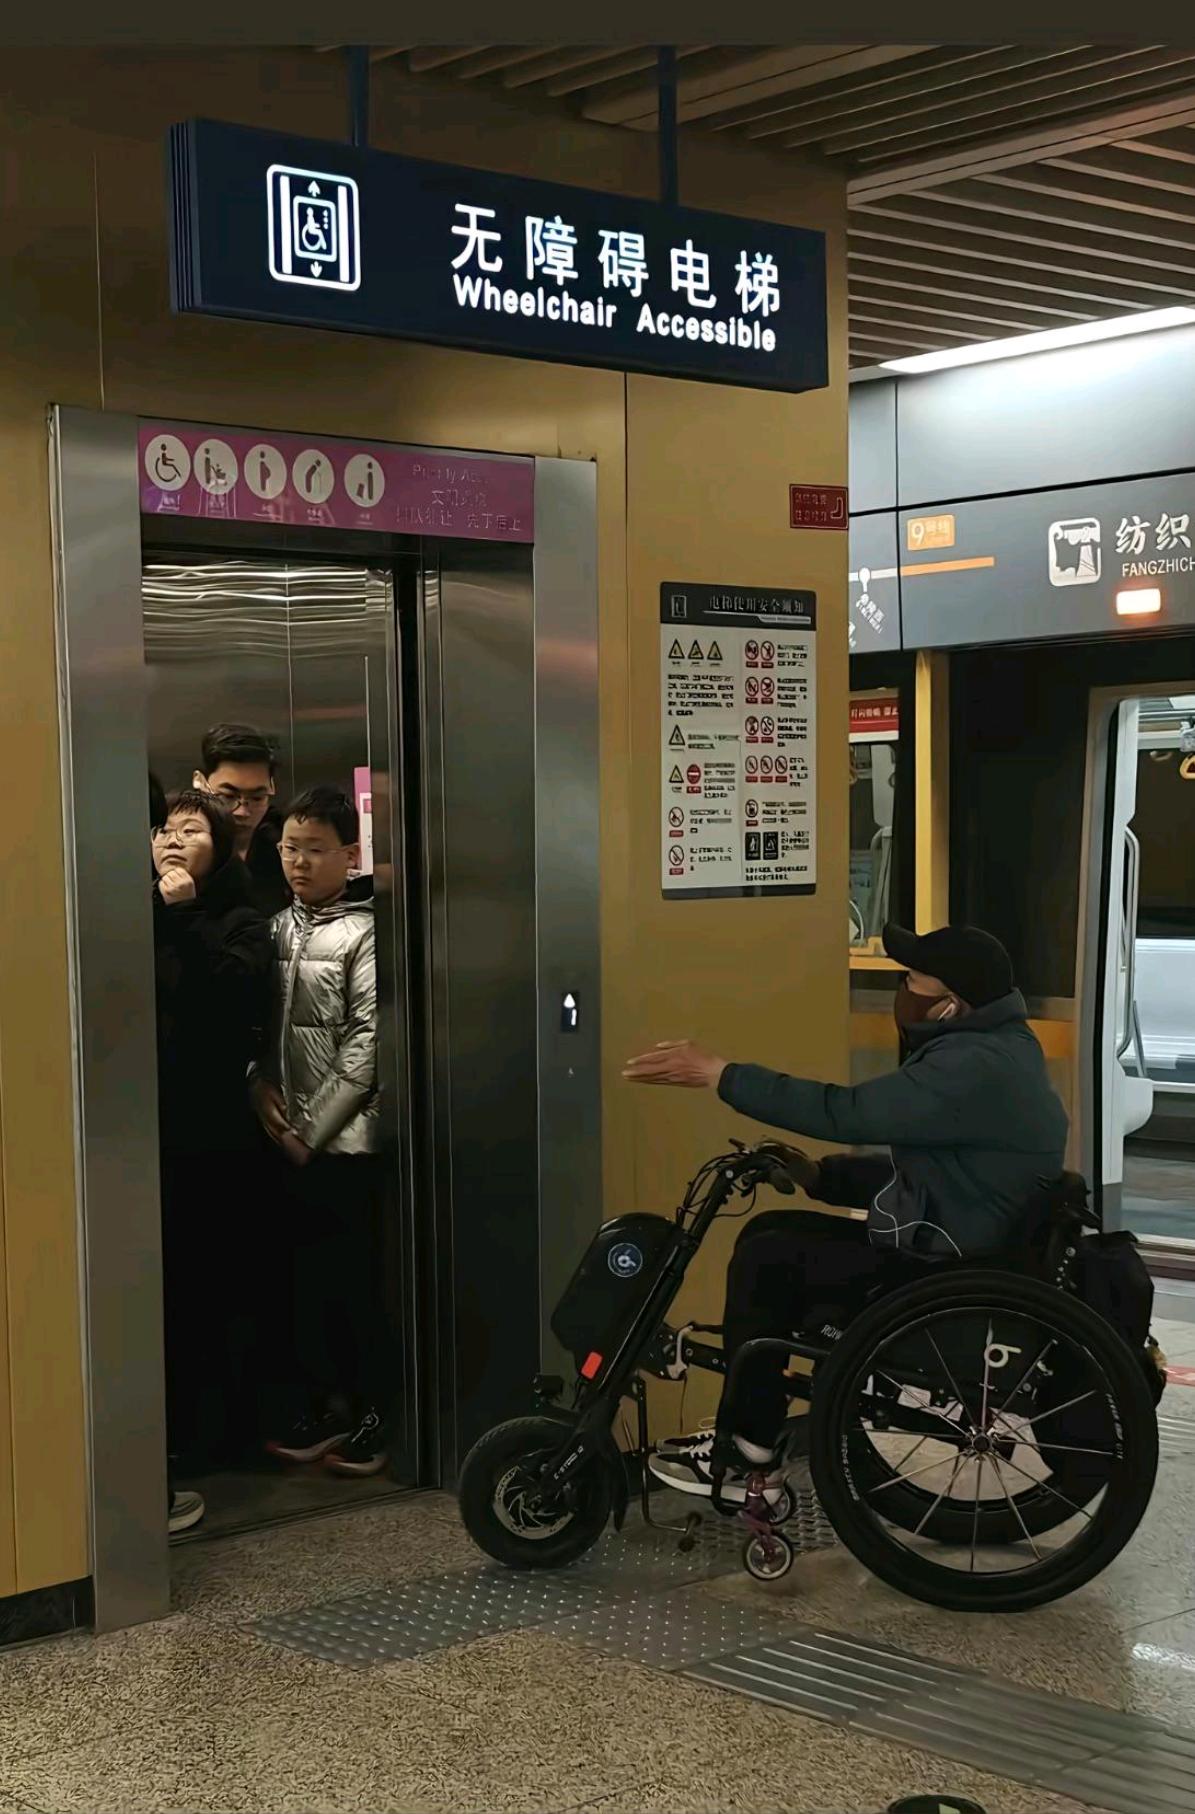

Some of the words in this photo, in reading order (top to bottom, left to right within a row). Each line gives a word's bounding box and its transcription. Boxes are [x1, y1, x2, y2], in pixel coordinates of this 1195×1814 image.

[451, 203, 780, 317] 无障碍电梯
[453, 273, 617, 328] Wheelchair
[636, 303, 776, 352] Accessible
[1115, 513, 1192, 555] 纺织
